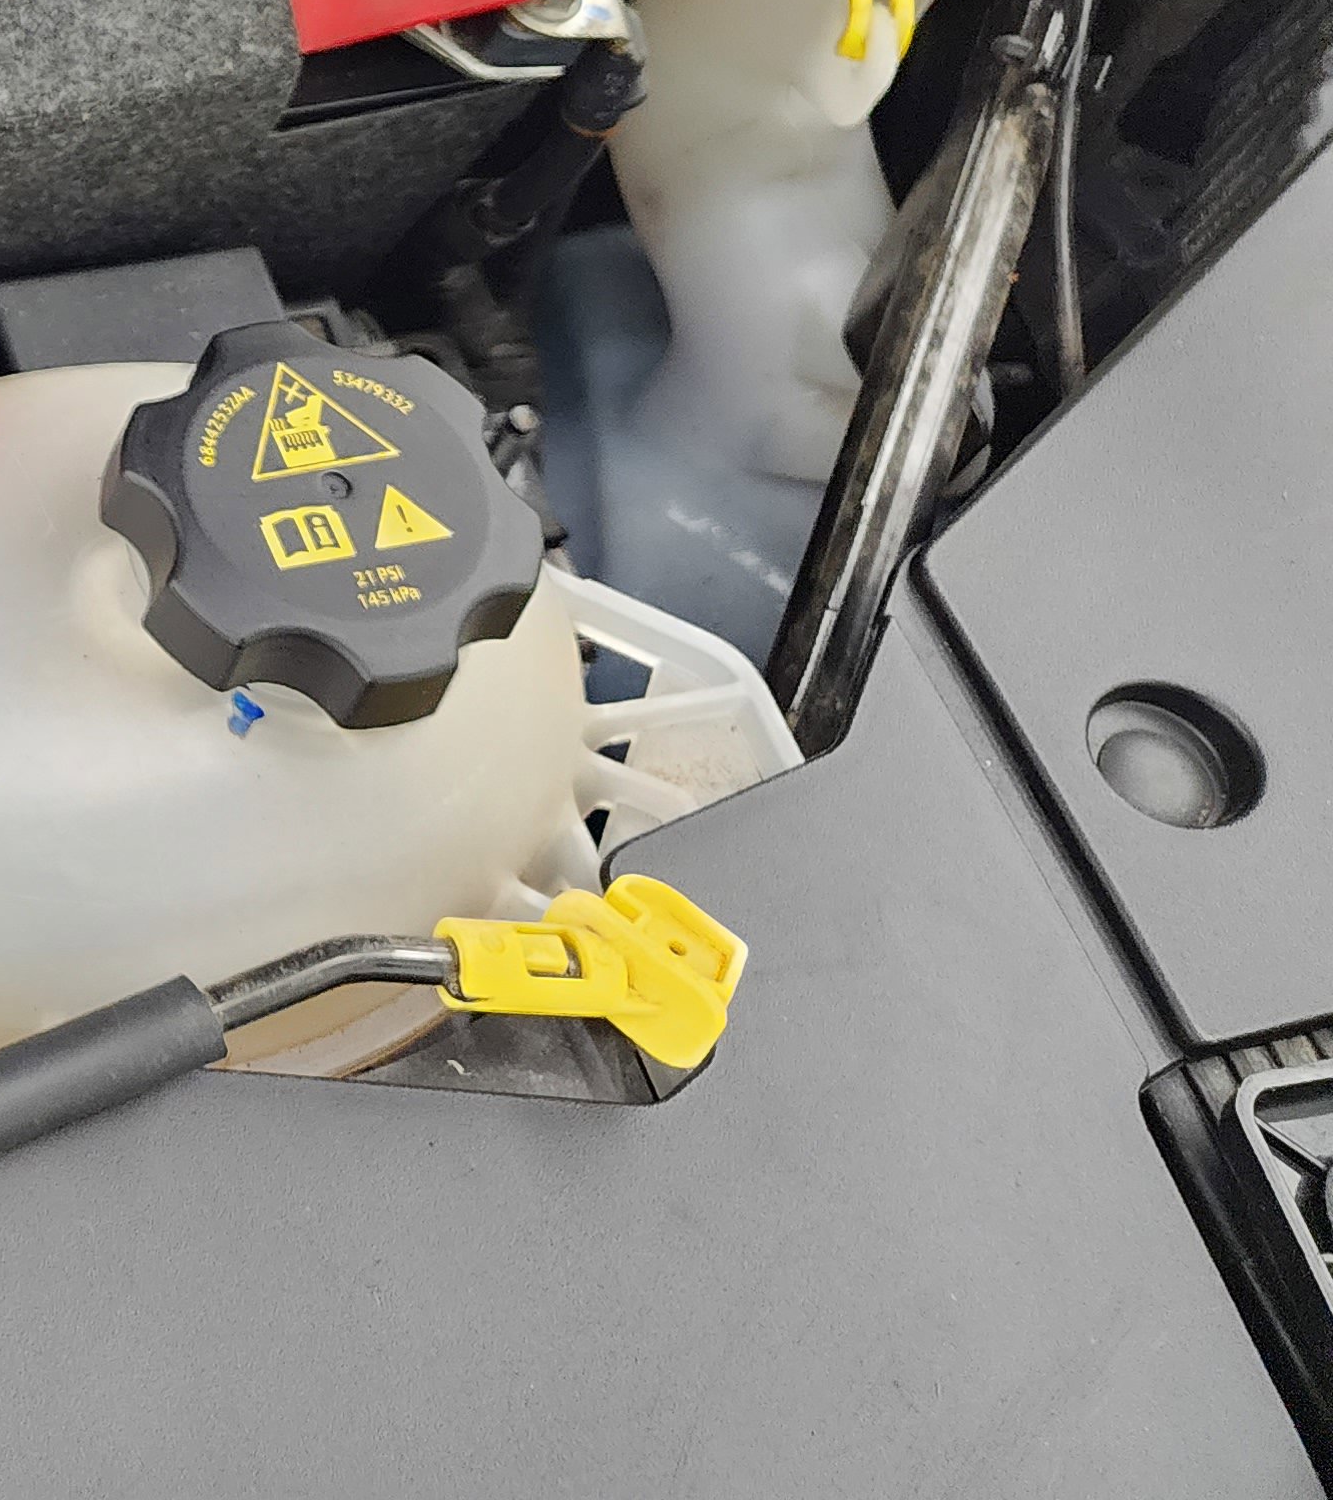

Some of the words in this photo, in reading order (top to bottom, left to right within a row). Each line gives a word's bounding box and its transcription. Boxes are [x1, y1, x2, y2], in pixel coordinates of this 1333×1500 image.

[332, 369, 416, 417] 53479332
[197, 386, 256, 468] 68442532AA
[353, 569, 376, 588] 21
[376, 564, 406, 584] PSI
[357, 589, 391, 610] 145
[389, 585, 422, 605] kPa
